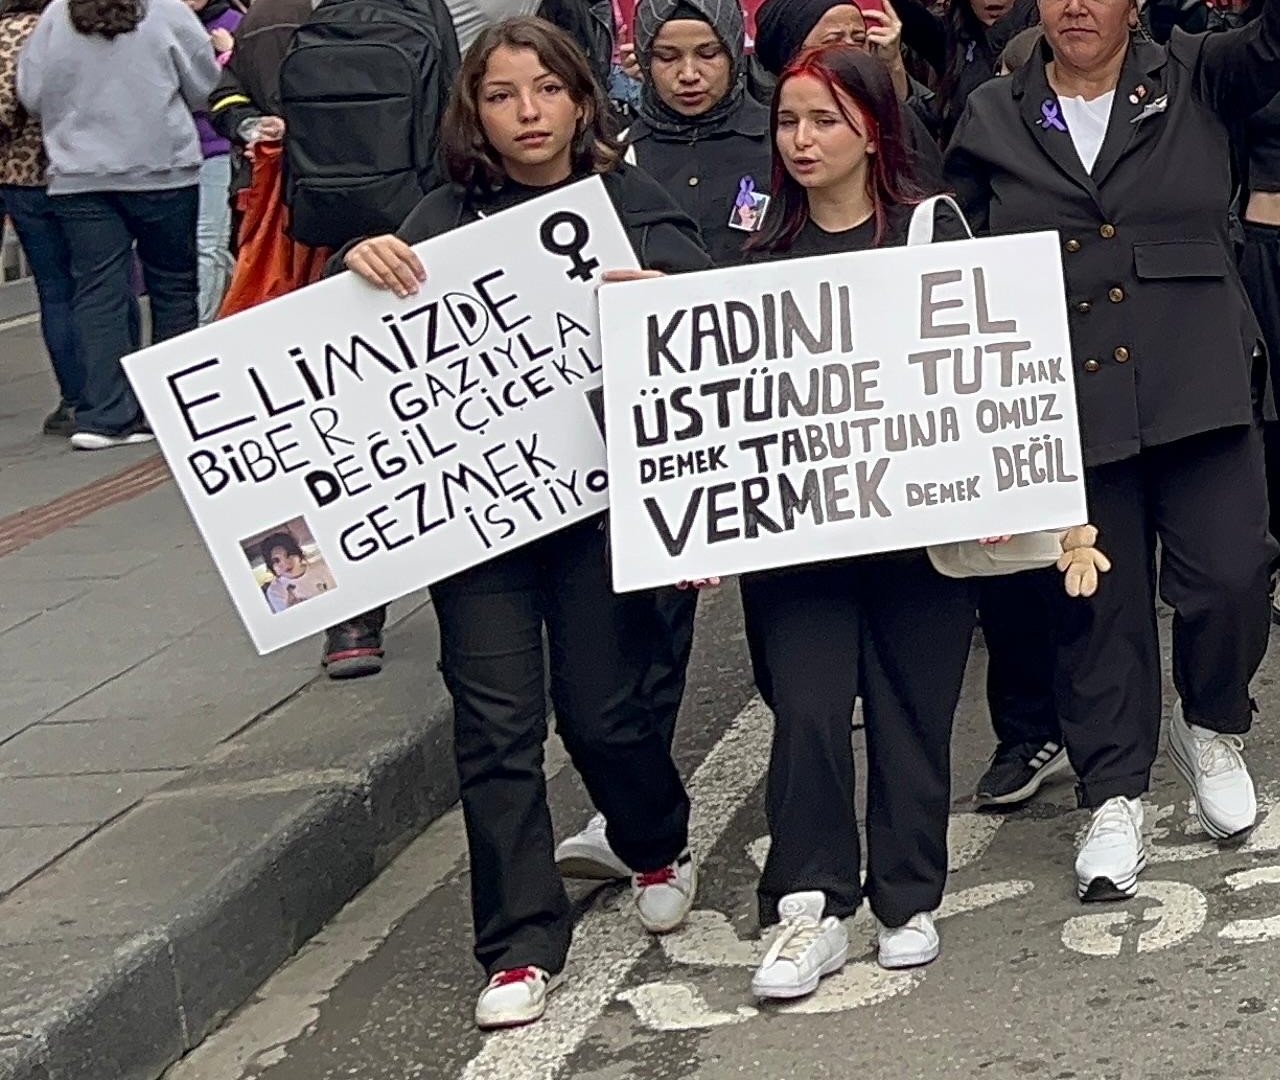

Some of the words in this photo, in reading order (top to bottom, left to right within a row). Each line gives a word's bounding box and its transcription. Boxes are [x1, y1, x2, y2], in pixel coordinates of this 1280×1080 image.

[164, 267, 533, 442] ELİMİZDE
[645, 280, 855, 378] KADINI
[917, 267, 1019, 339] EL
[185, 405, 357, 497] BİBER
[386, 310, 592, 425] GAZIYLA
[304, 422, 460, 509] DEĞİL
[453, 350, 602, 434] ÇİÇEKL
[631, 357, 883, 450] ÜSTÜNDE
[638, 445, 730, 485] DEMEK
[742, 404, 961, 476] TABUTUNA
[974, 392, 1064, 433] OMUZ
[338, 431, 558, 563] GEZMEK
[462, 466, 608, 552] İSTİYO
[642, 457, 893, 559] VERMEK
[904, 473, 981, 509] DEMEK
[991, 432, 1078, 493] DEĞİL
